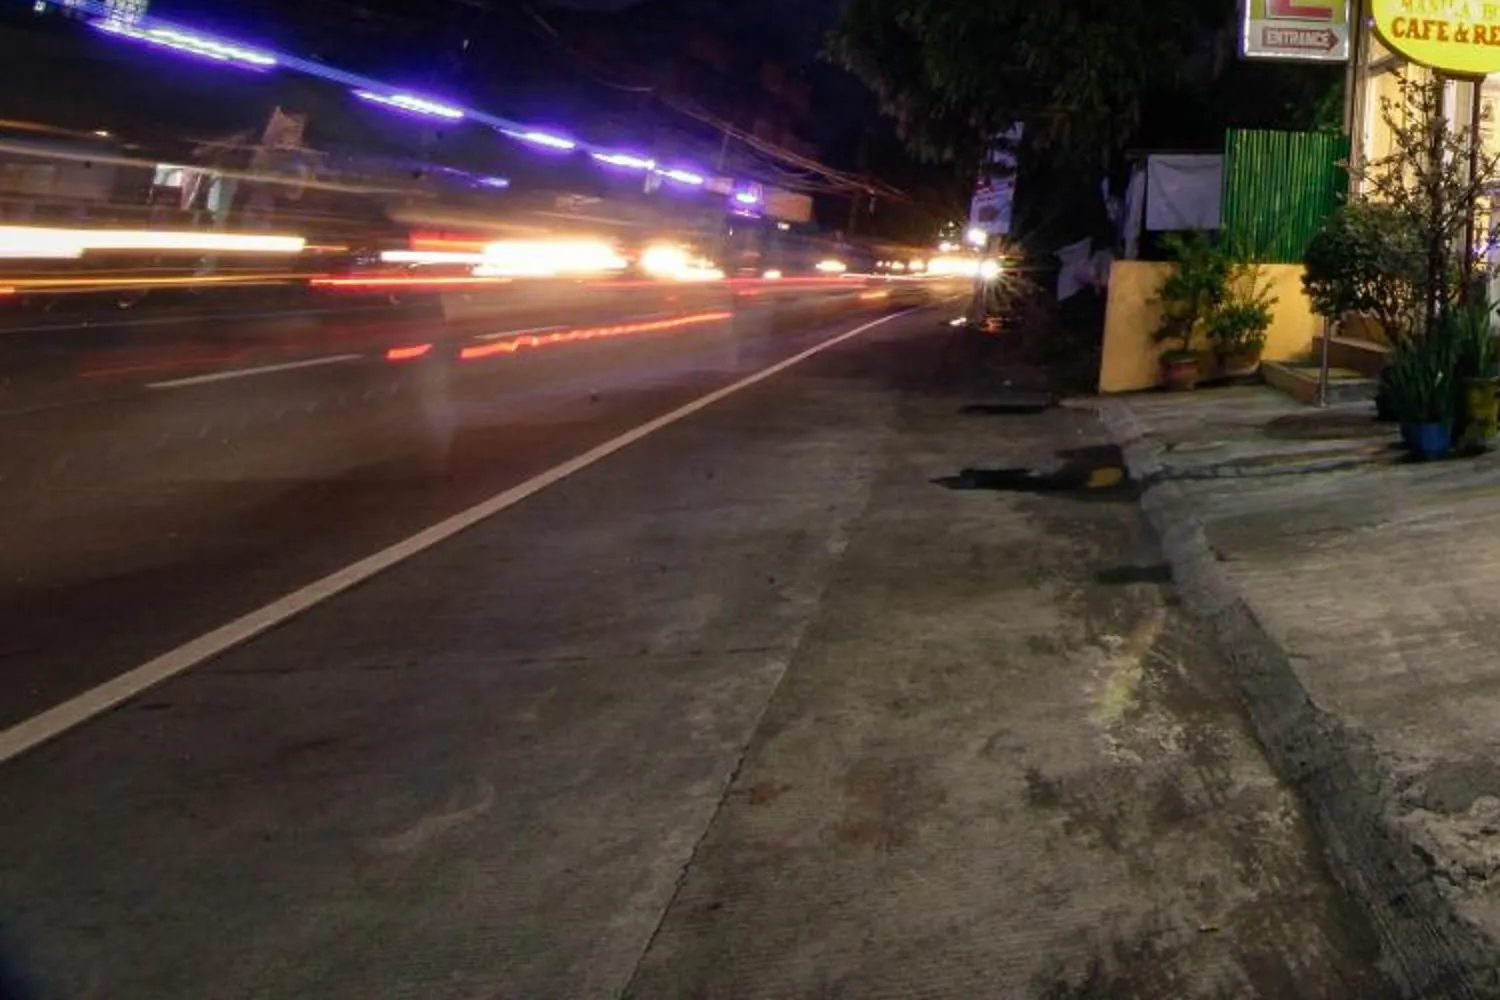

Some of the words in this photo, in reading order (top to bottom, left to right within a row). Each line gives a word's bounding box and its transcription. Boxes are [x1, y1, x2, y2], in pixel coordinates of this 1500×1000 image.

[1267, 30, 1329, 46] ENTRANCE
[1391, 17, 1450, 43] CAFE
[1454, 22, 1471, 43] &
